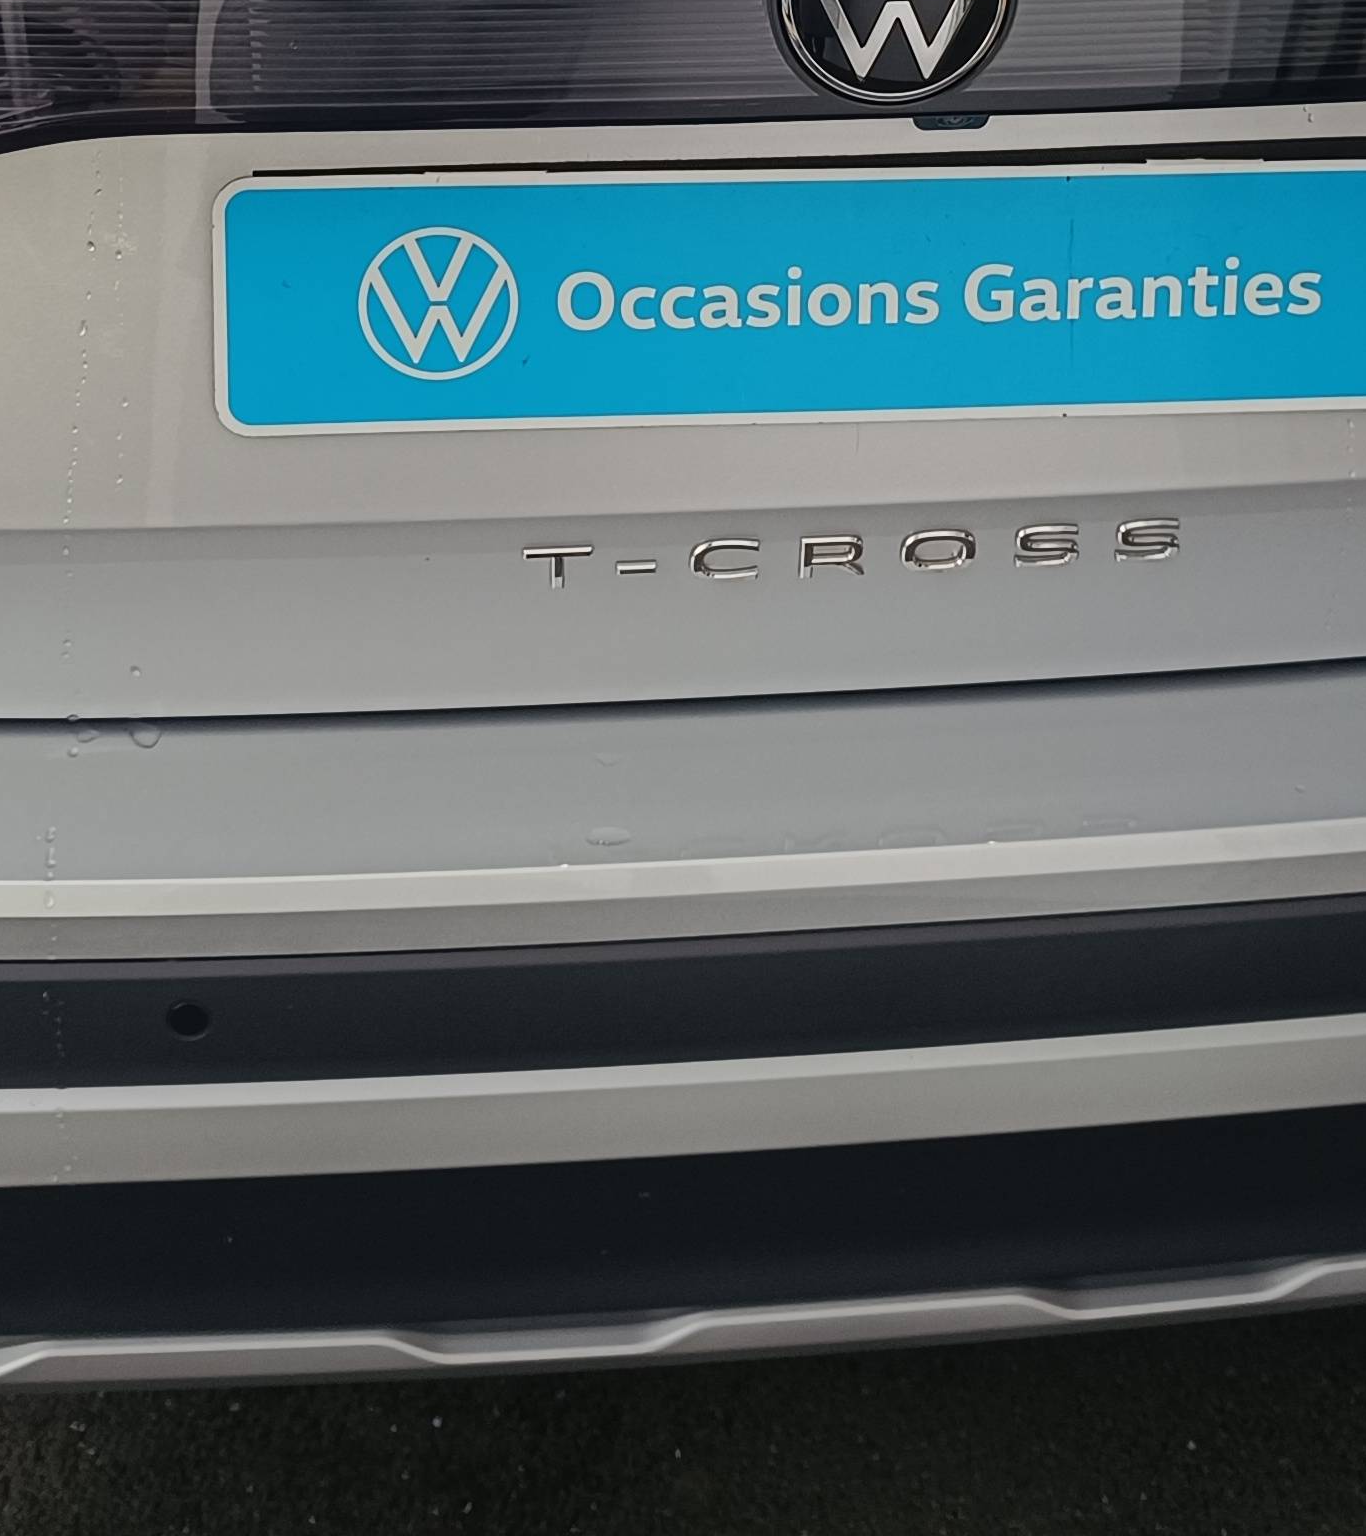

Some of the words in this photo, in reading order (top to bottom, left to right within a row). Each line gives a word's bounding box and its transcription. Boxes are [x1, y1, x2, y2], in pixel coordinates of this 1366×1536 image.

[358, 227, 519, 380] VW
[556, 265, 940, 332] Occasions
[963, 256, 1323, 323] Garanties
[521, 516, 1181, 589] T-CROSS
